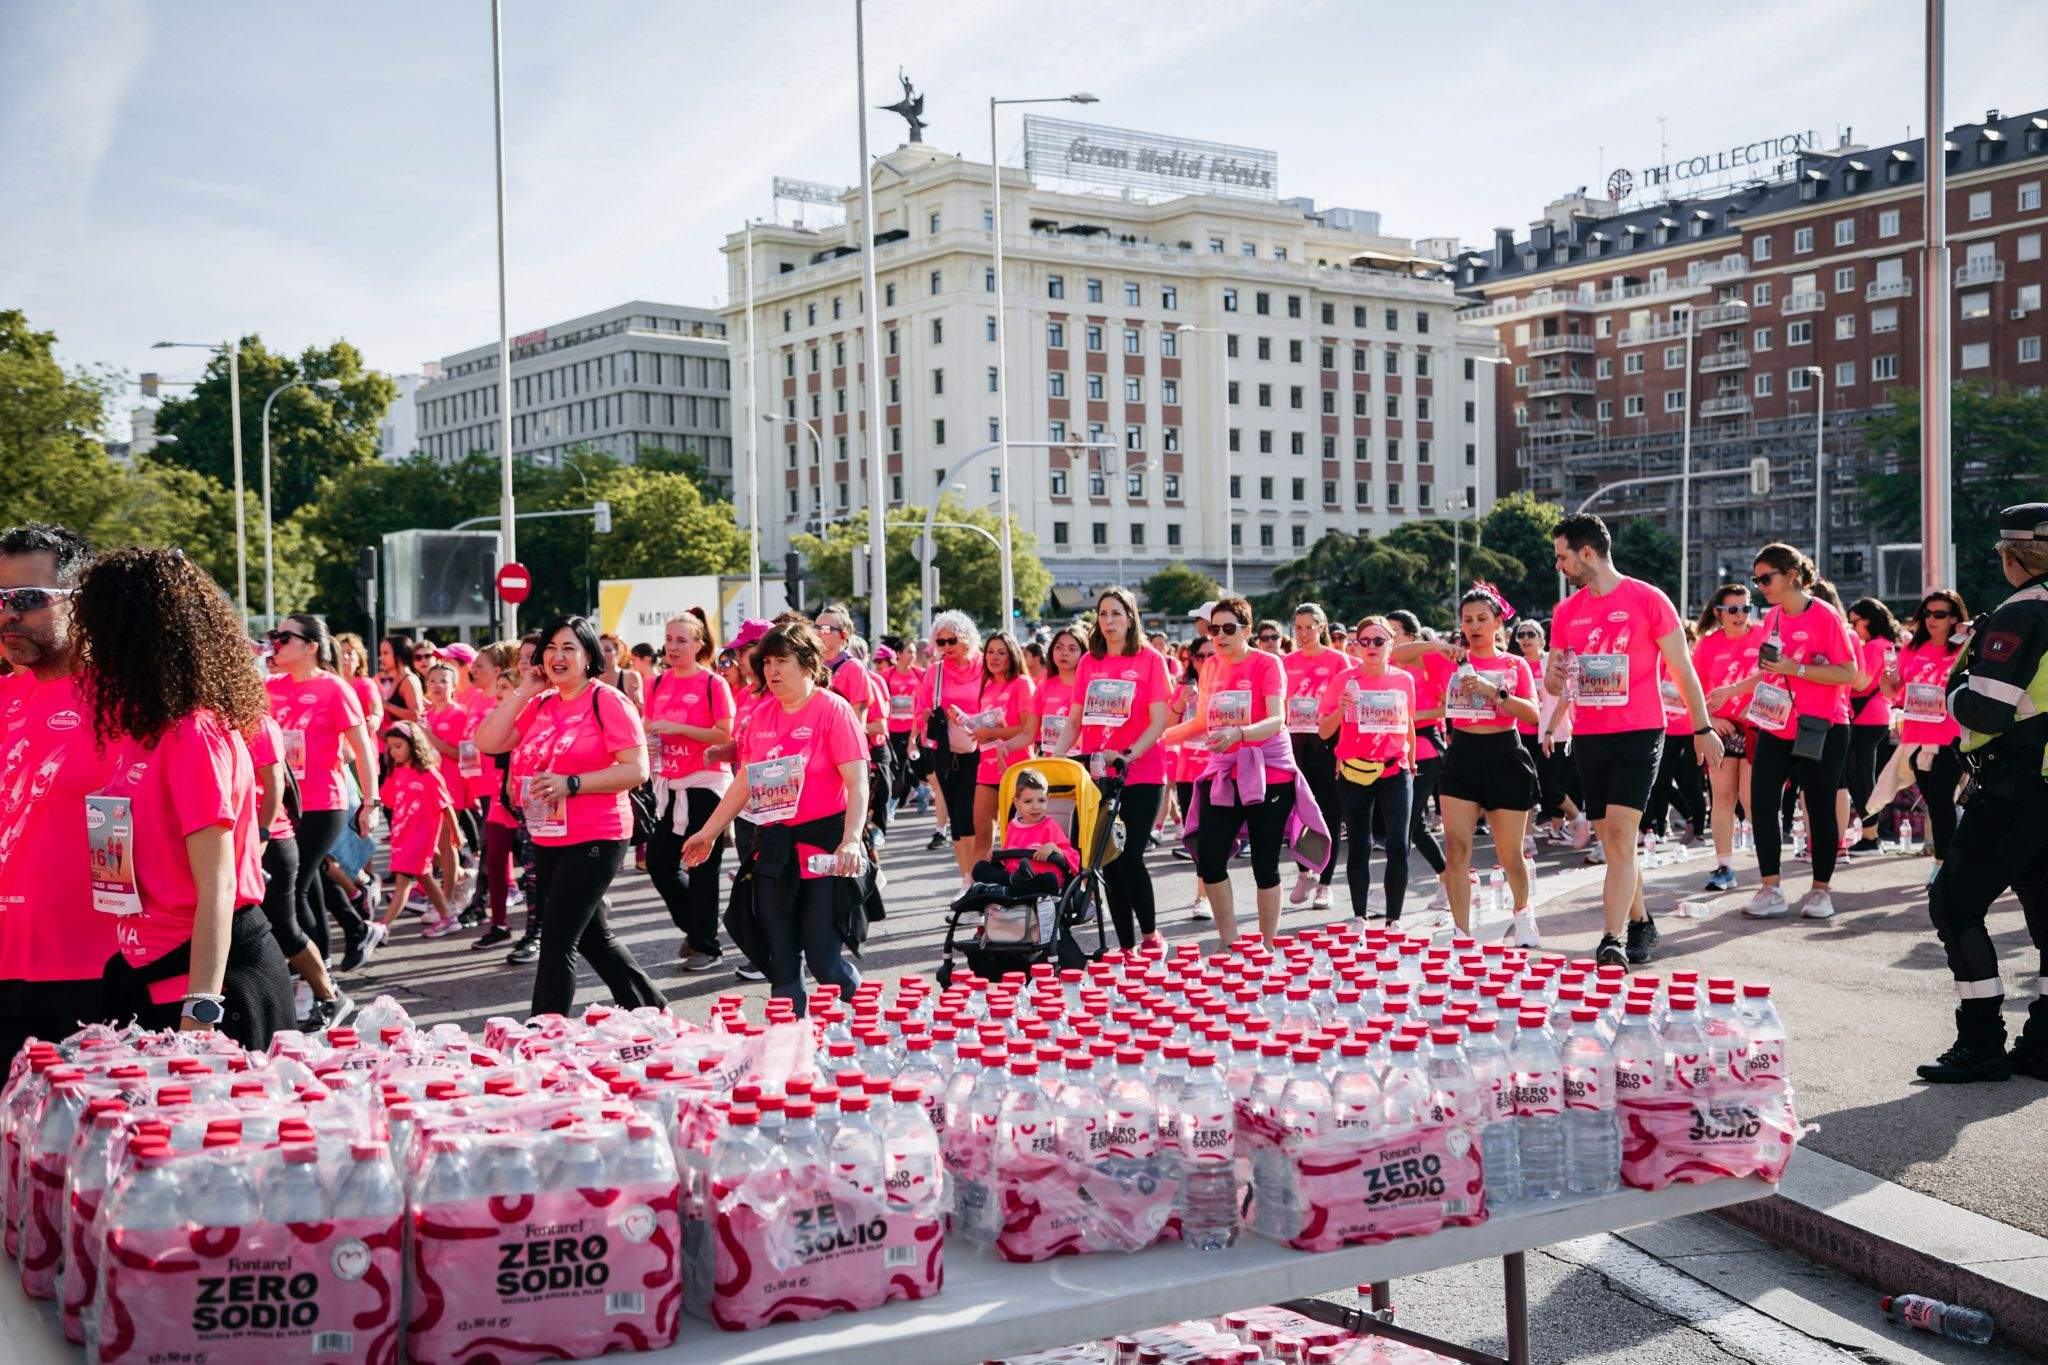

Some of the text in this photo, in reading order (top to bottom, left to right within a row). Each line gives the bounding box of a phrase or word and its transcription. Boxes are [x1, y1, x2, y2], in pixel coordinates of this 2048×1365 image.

[1069, 136, 1129, 170] Gran
[1676, 130, 1814, 179] COLLECTION
[1193, 1129, 1227, 1139] ZERO
[1193, 1138, 1228, 1148] SODIO
[1380, 1142, 1422, 1162] Fontarel
[1363, 1154, 1441, 1191] ZERO
[227, 1256, 292, 1273] Fontarel
[498, 1235, 608, 1270] ZERO
[196, 1272, 319, 1305] ZERO
[496, 1263, 609, 1296] SODIO
[192, 1301, 320, 1332] SODIO
